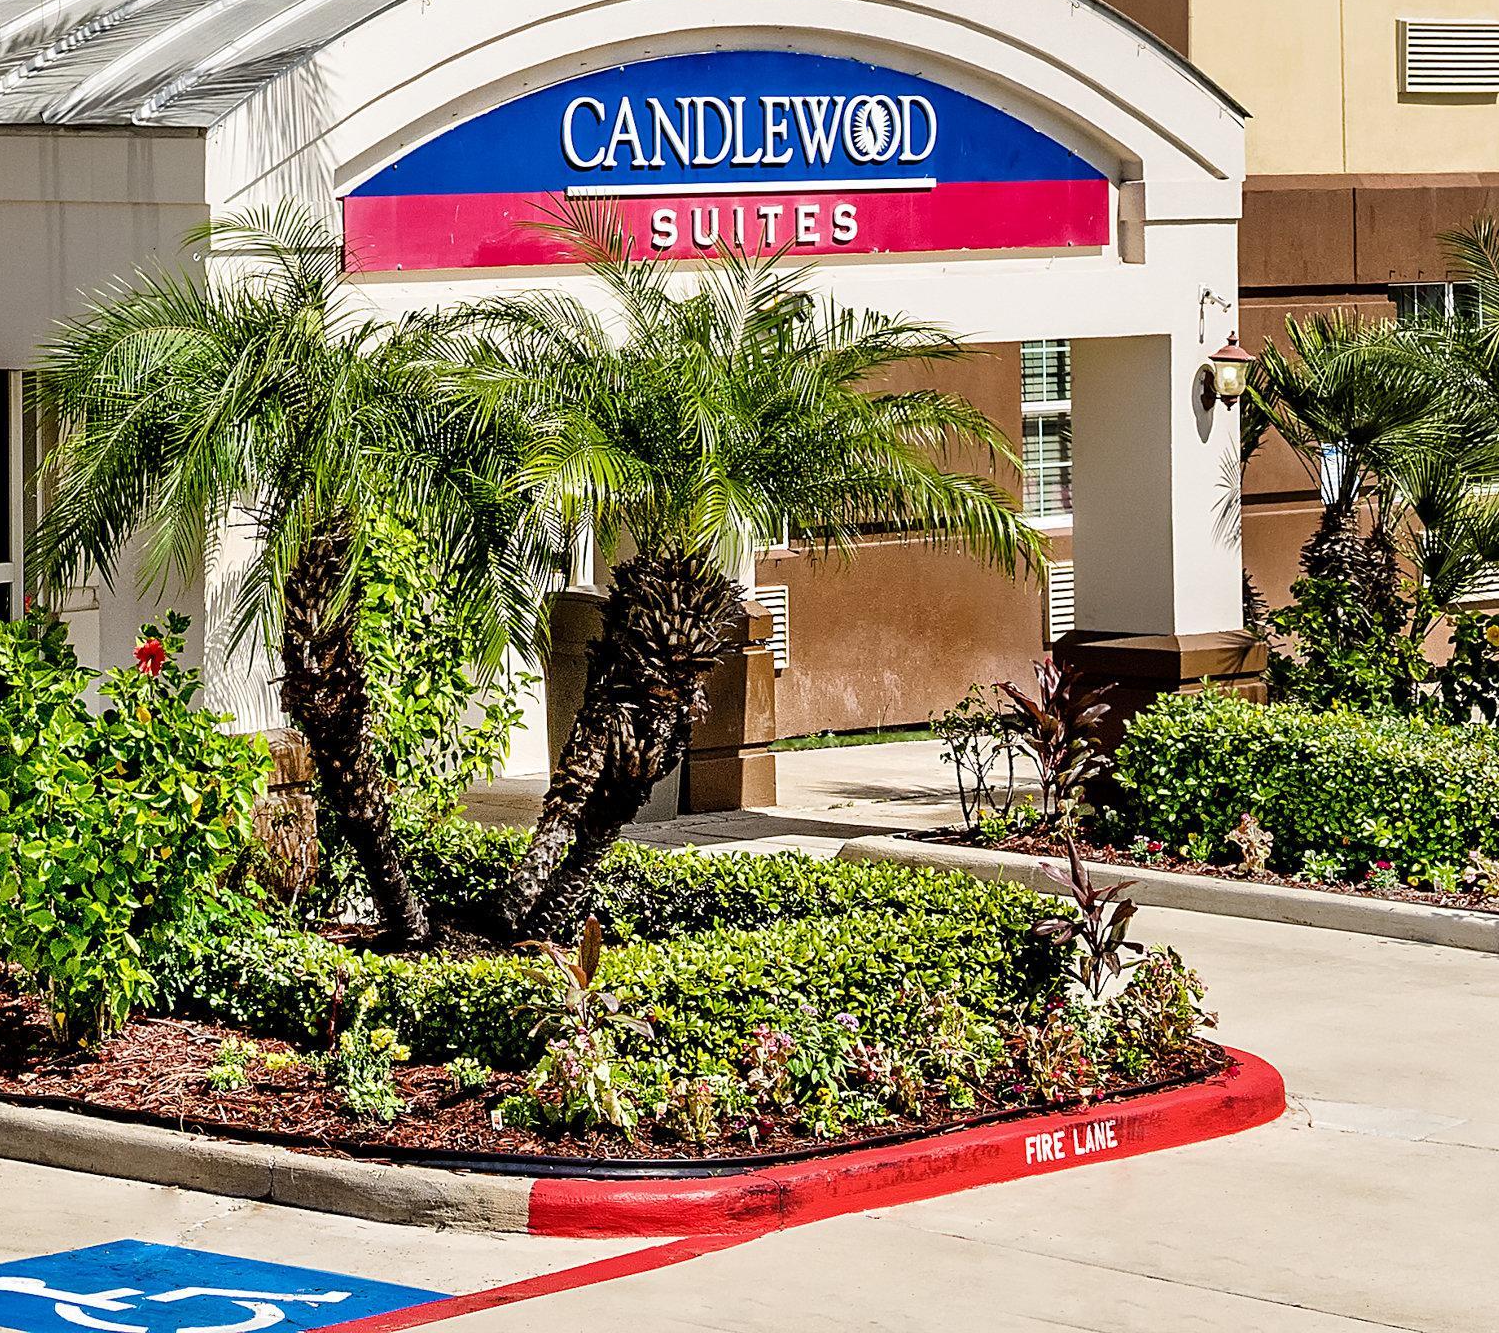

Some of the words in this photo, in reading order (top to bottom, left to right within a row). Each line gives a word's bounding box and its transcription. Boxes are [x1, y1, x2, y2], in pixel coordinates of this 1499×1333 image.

[562, 95, 937, 168] CANDLEWOOD
[651, 204, 859, 248] SUITES
[1025, 1131, 1066, 1164] FIRE
[1073, 1120, 1118, 1155] LANE
